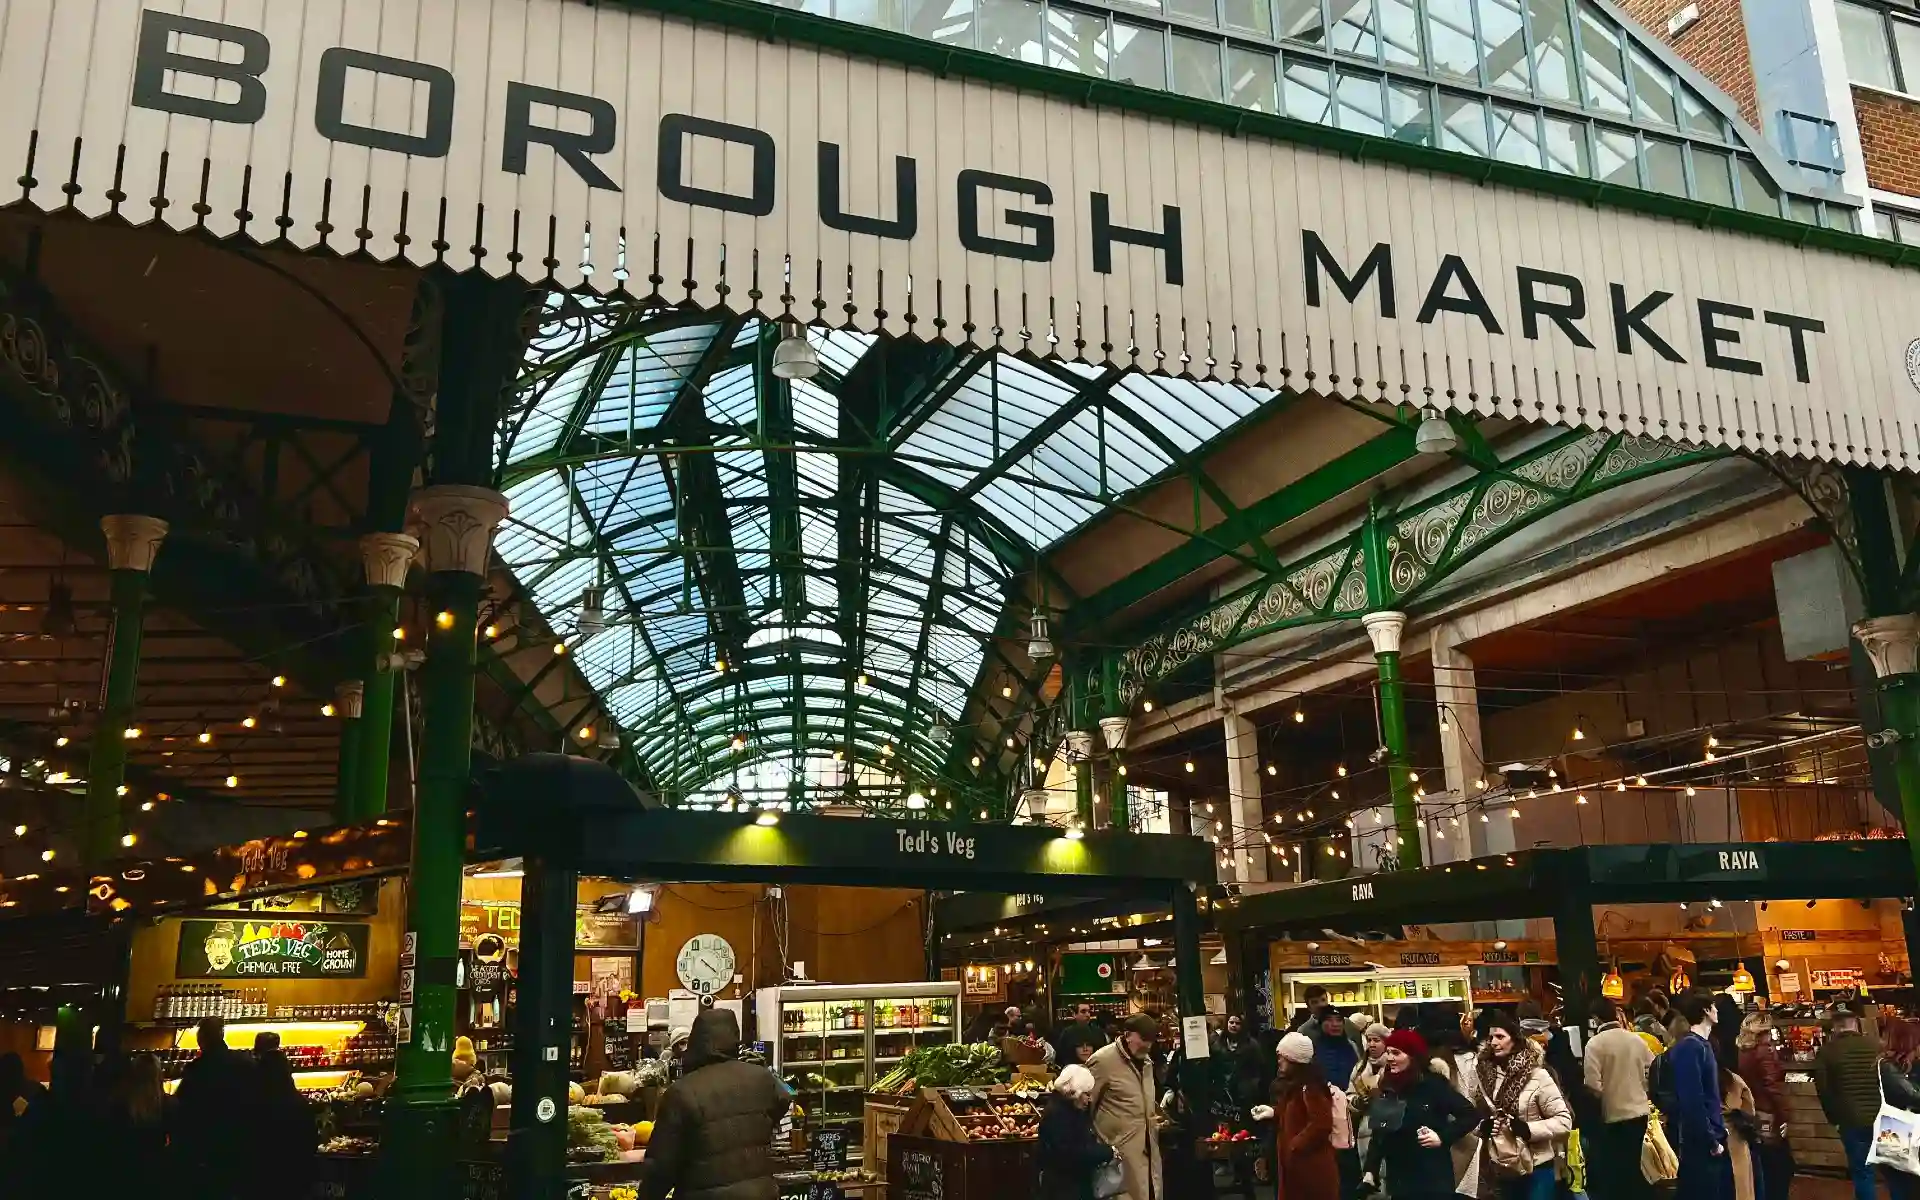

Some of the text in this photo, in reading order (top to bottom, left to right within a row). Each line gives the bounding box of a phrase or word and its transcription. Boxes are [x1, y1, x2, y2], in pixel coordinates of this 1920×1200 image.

[131, 8, 1825, 384] BOROUGH MARKET
[896, 828, 975, 859] Ted's Veg
[241, 844, 288, 873] Ted's Veg
[1719, 851, 1759, 870] RAYA
[1352, 882, 1374, 901] RAYA
[238, 937, 313, 959] TED'S VEG
[326, 949, 350, 959] HOME
[236, 961, 302, 974] CHEMICAL FREE
